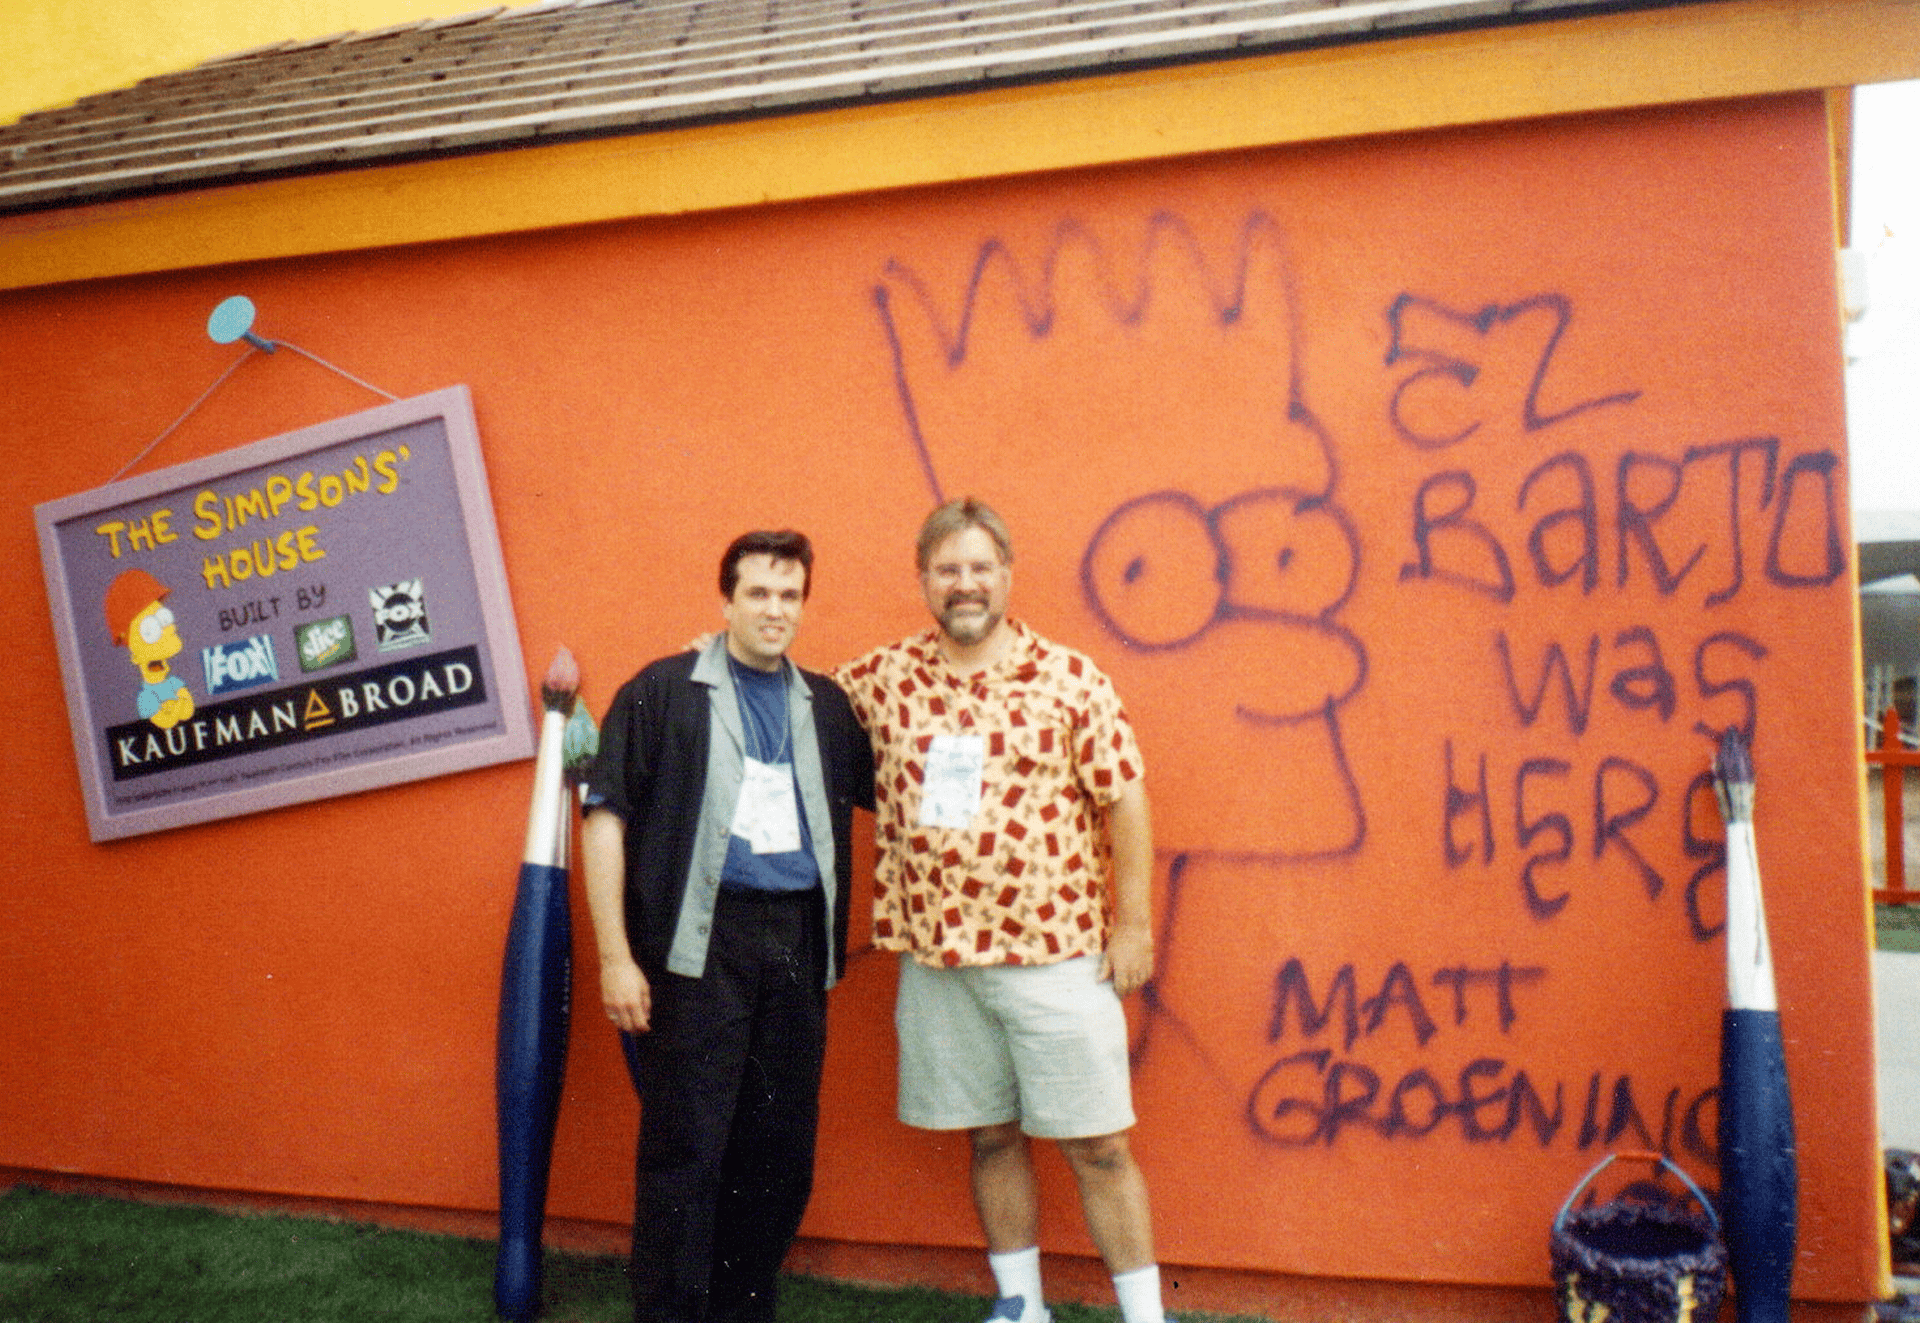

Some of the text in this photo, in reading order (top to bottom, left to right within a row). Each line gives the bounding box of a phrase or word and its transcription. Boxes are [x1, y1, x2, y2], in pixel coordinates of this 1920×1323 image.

[96, 444, 411, 559] THE SIMPSONS'
[203, 524, 326, 589] HOUSE
[218, 597, 281, 632] BUILT
[373, 599, 427, 627] FOX
[210, 637, 272, 686] FOX
[117, 662, 476, 767] KAUFMAN BROAD
[1444, 737, 1728, 941] HERE
[1266, 957, 1548, 1053] MATT
